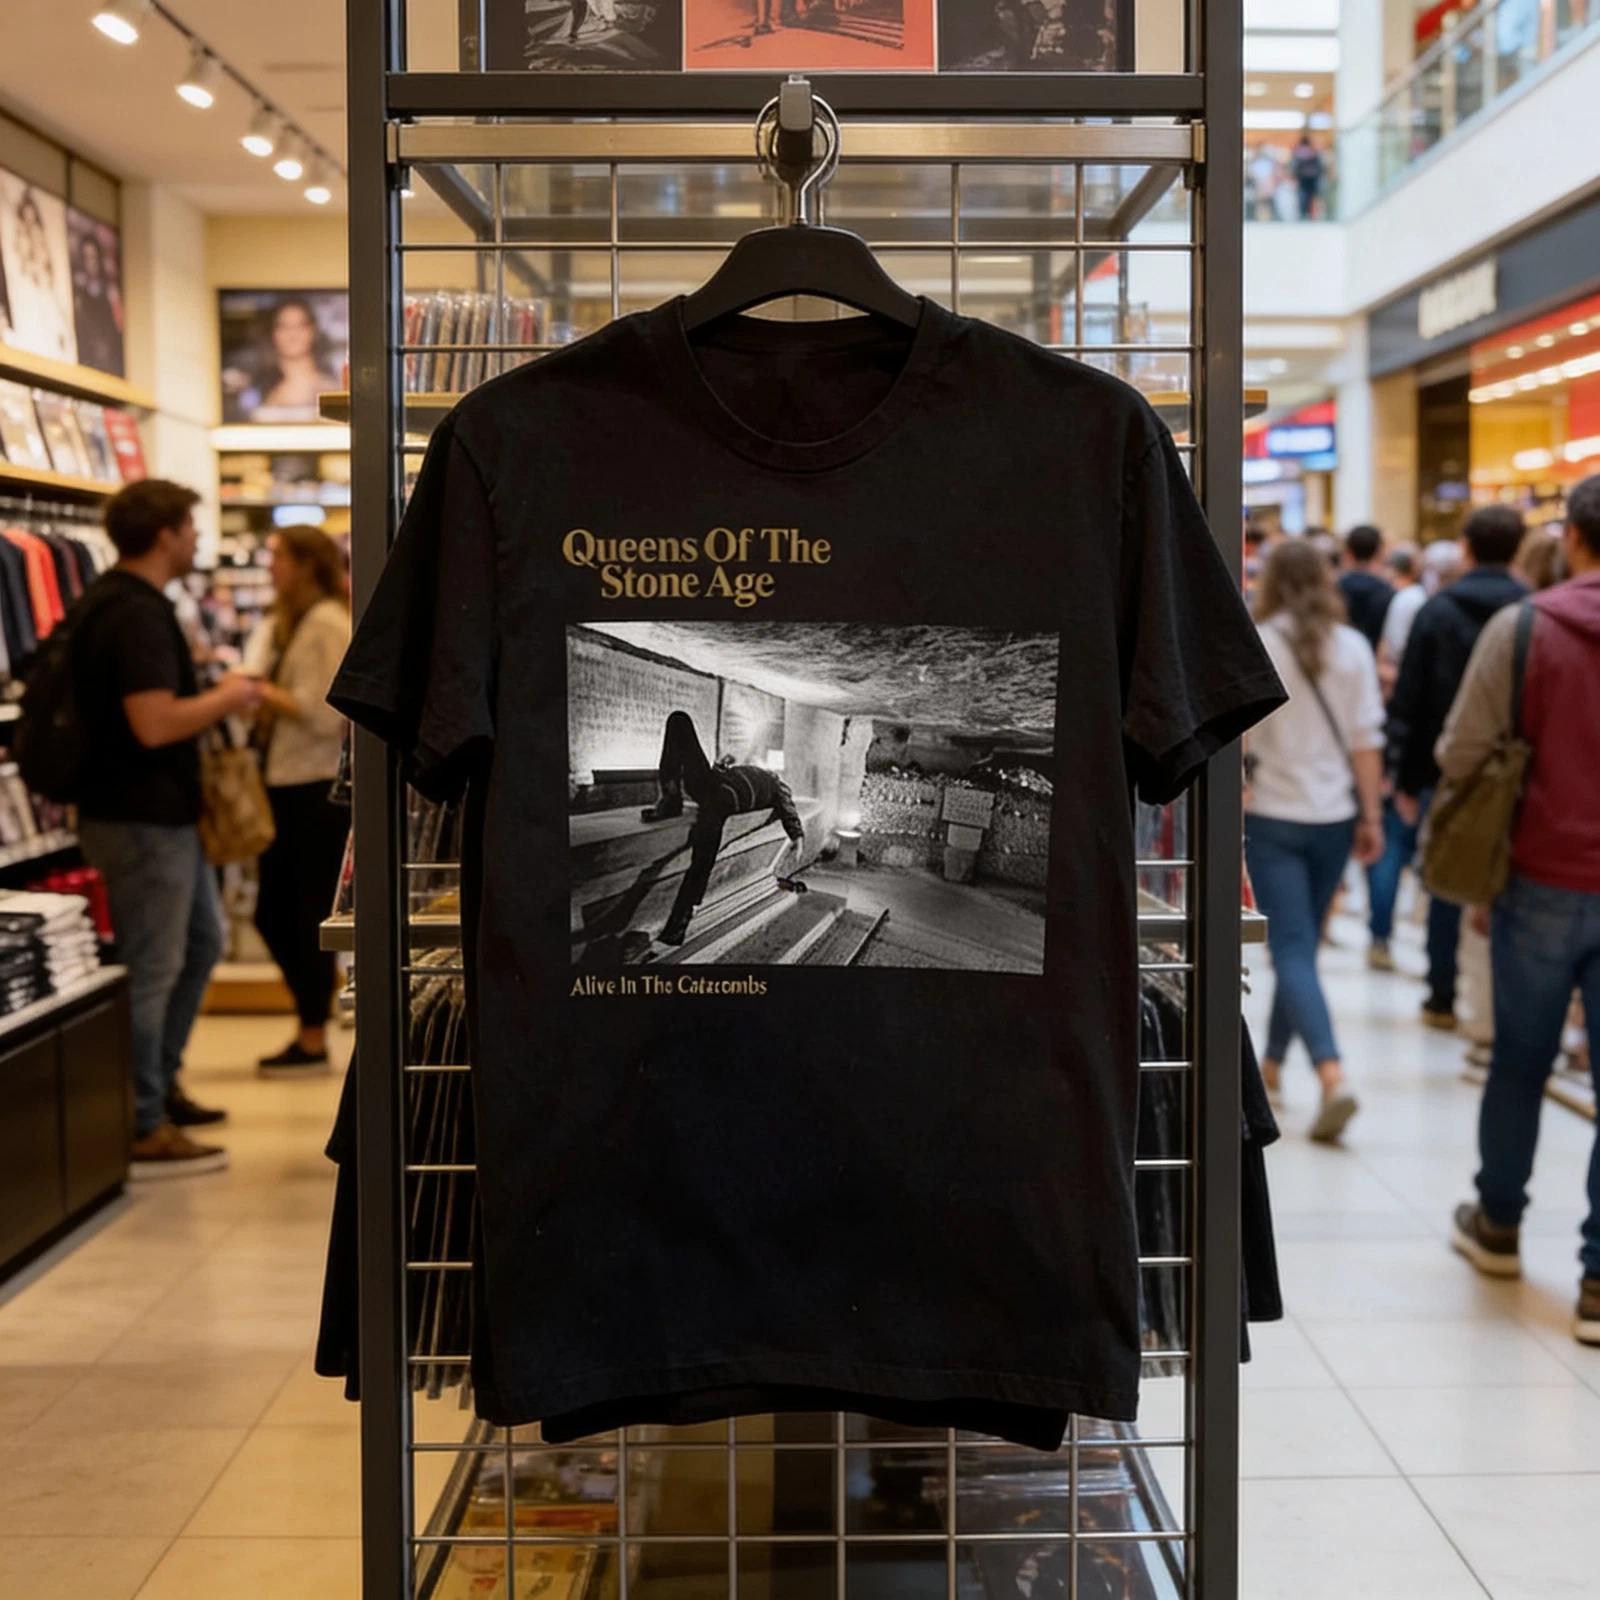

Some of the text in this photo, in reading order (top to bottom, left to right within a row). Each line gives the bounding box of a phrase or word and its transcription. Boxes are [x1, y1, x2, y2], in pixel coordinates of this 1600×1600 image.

[562, 527, 832, 569] Queens Of The
[601, 563, 775, 608] Stone Age
[569, 975, 616, 997] Alive
[620, 975, 637, 995] In
[641, 975, 673, 995] The
